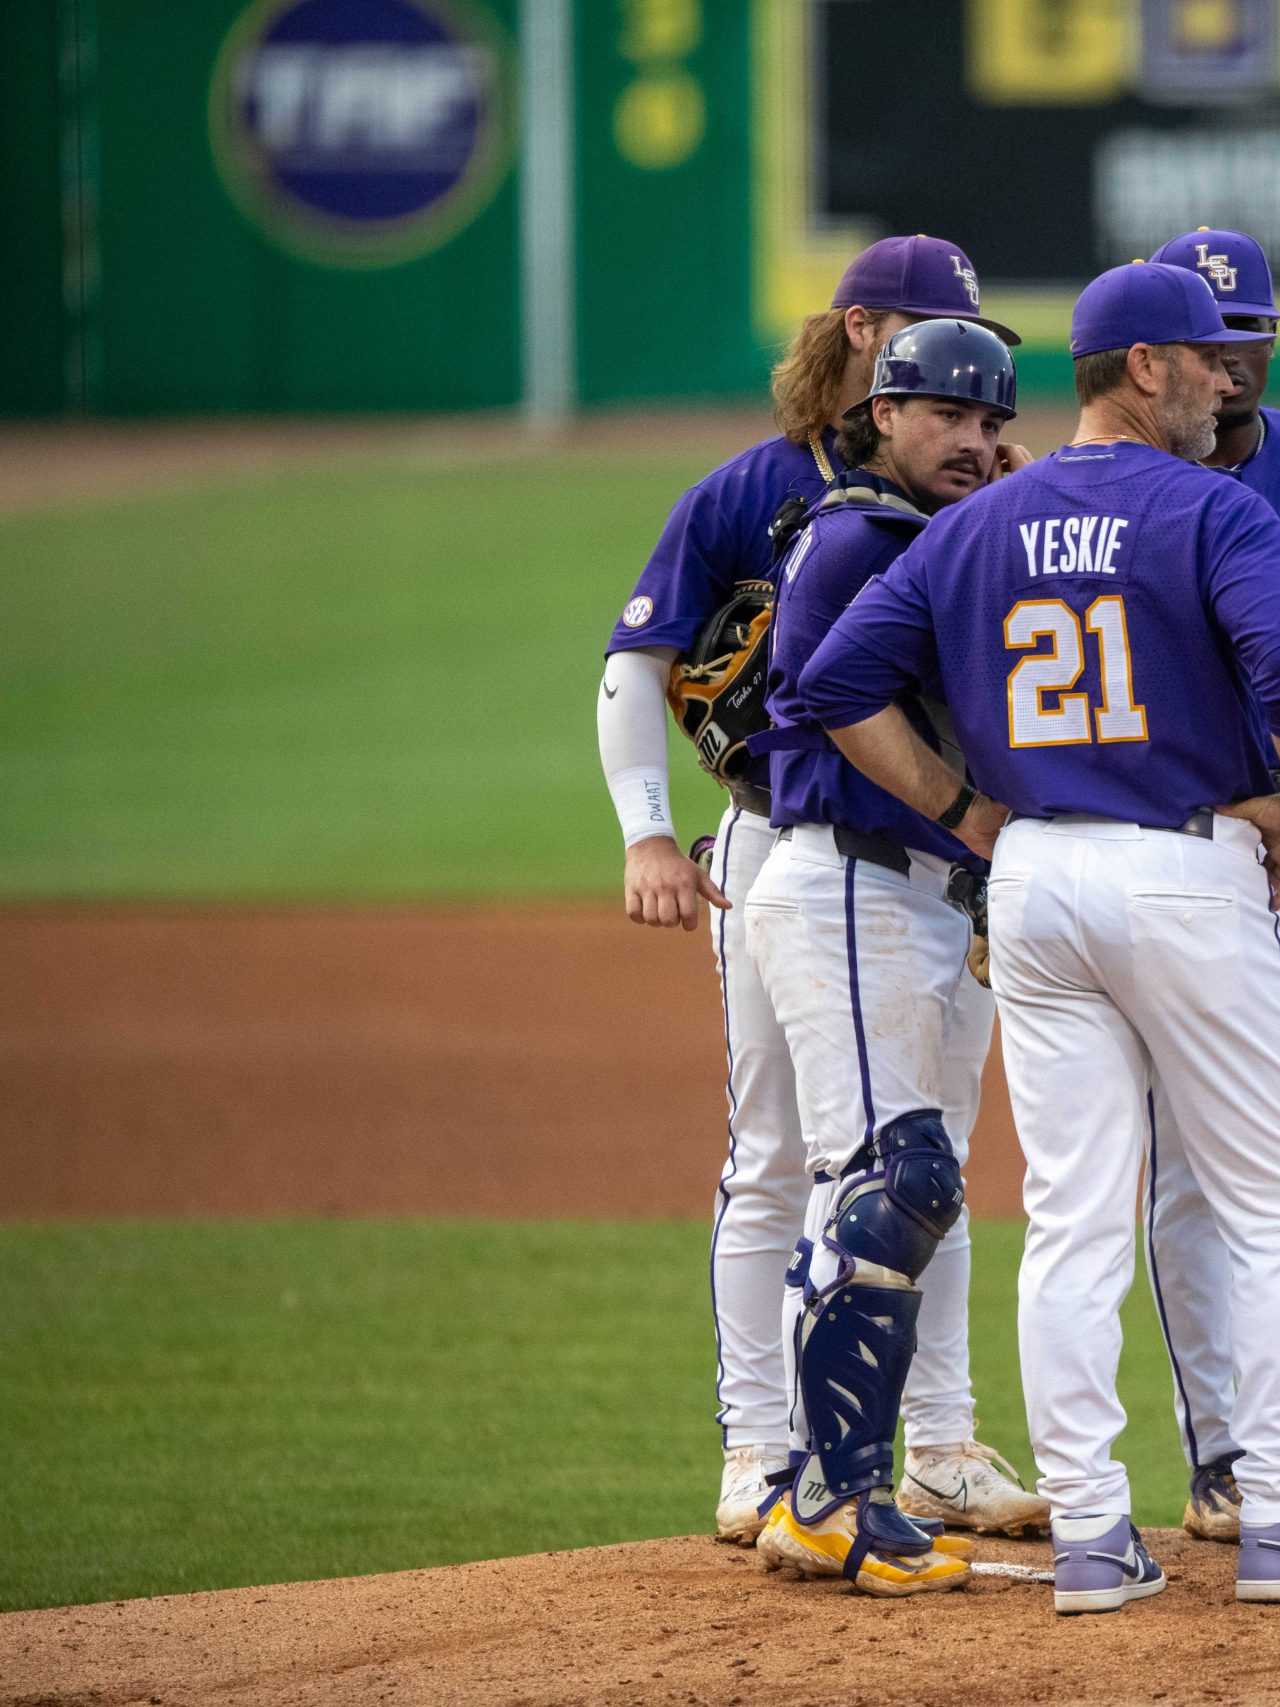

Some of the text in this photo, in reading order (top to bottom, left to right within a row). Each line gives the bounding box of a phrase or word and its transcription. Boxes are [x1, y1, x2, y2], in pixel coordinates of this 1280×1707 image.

[949, 255, 980, 306] LSU
[1195, 243, 1238, 293] LSU
[1018, 515, 1130, 578] YESKIE
[1002, 594, 1151, 749] 21
